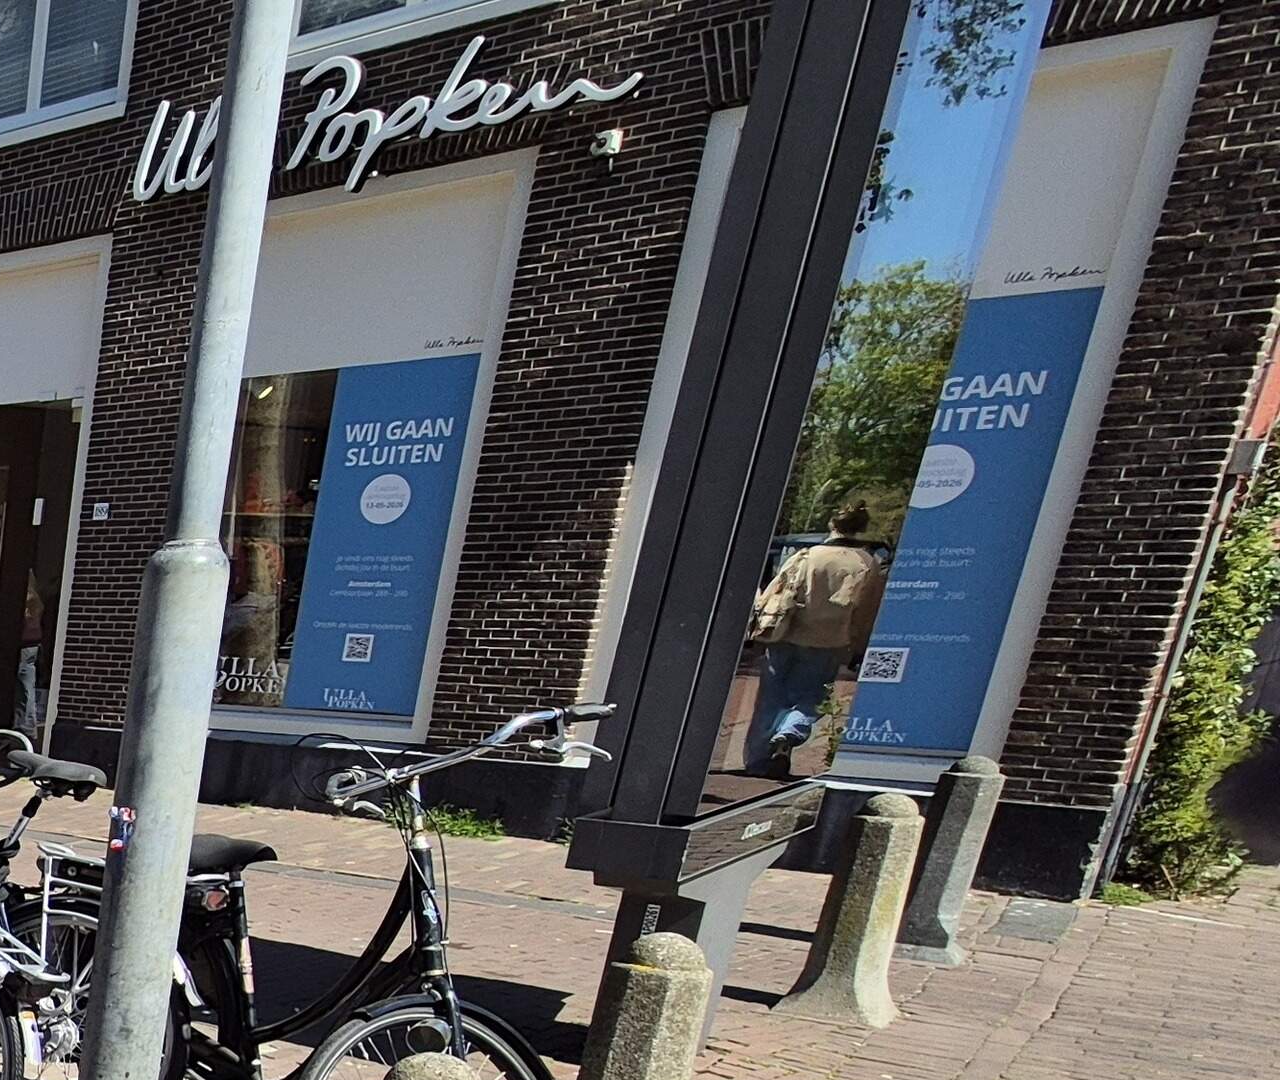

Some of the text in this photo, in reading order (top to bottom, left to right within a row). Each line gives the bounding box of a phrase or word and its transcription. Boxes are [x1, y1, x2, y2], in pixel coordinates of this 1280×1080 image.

[131, 35, 644, 201] Ul Popken
[940, 370, 1048, 402] GAAN
[345, 417, 455, 446] WIJ GAAN
[344, 443, 444, 467] SLUITEN
[347, 580, 392, 588] Amsterdam
[215, 670, 285, 696] OPKE
[323, 688, 366, 702] ULLA
[327, 695, 376, 710] POPKEN
